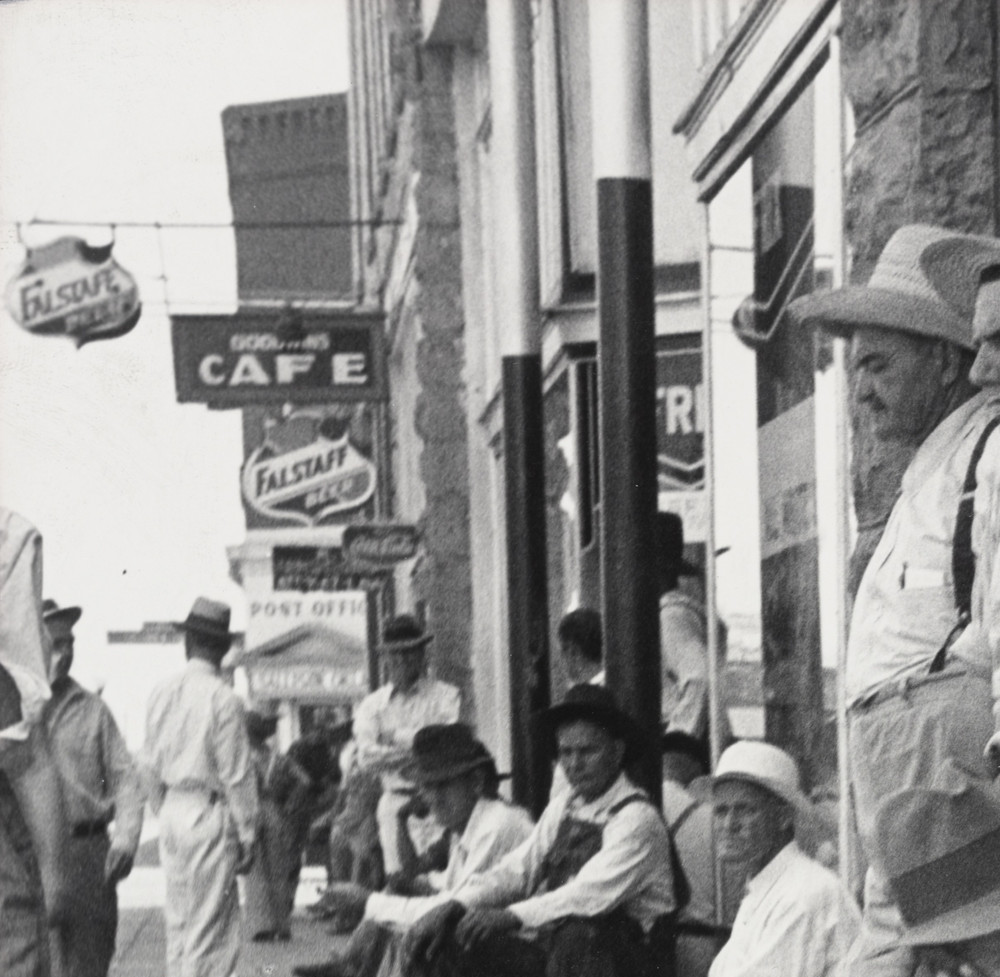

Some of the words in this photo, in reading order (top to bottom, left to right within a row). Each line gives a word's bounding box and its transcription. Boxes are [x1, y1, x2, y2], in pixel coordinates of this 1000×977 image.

[198, 353, 368, 387] CAFE
[255, 447, 348, 498] FALSTAFF
[249, 600, 302, 619] POST
